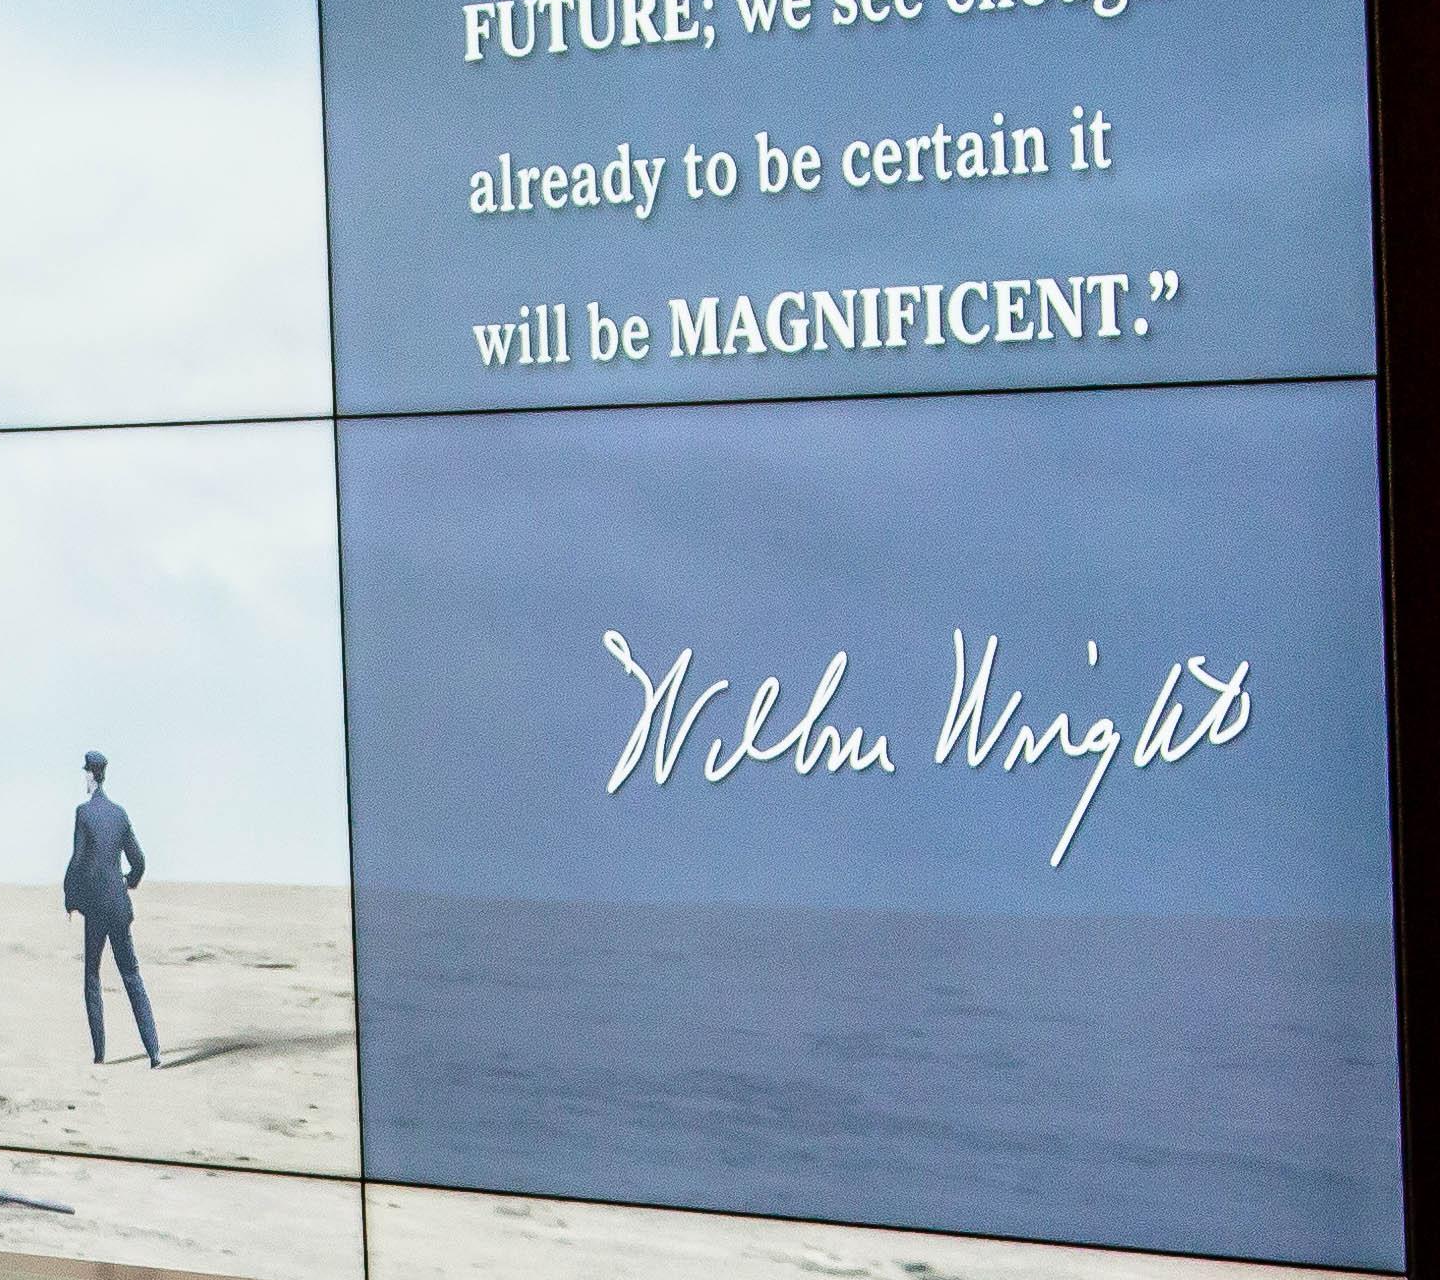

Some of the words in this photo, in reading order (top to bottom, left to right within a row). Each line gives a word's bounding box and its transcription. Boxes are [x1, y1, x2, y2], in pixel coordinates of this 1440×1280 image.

[469, 141, 667, 220] already
[682, 142, 738, 200] to
[753, 130, 822, 194] be
[840, 111, 1050, 187] certain
[1068, 104, 1113, 171] it
[471, 302, 572, 367] will
[585, 300, 651, 362] be
[666, 268, 1180, 359] MAGNIFICENT.”
